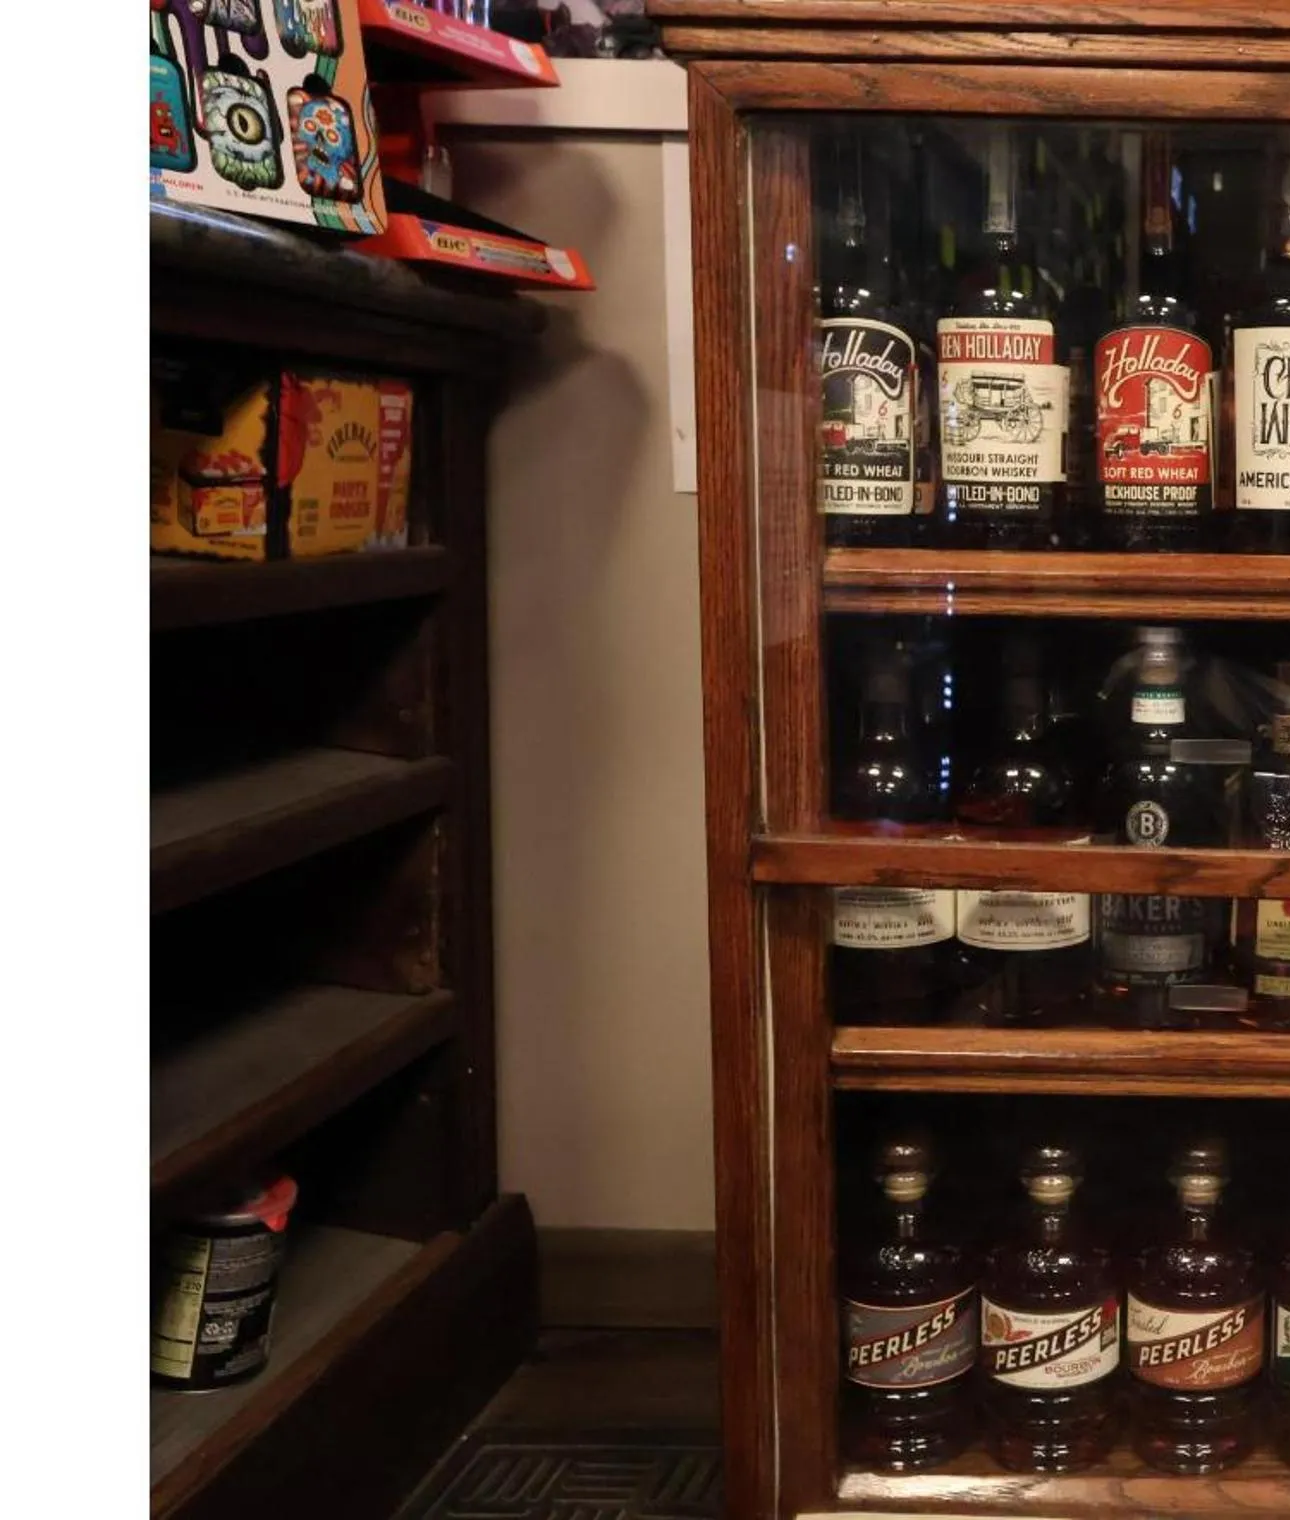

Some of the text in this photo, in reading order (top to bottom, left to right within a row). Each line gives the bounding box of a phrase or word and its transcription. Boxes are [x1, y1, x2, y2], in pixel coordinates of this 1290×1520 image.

[965, 334, 1041, 360] HOLLADAY
[1101, 335, 1200, 393] Holladay
[326, 422, 377, 460] FIREBALL
[834, 464, 859, 476] RED
[863, 464, 903, 477] WHEAT
[987, 453, 1039, 465] STRAIGHT
[991, 466, 1038, 477] WHISKEY
[1104, 467, 1199, 480] SOFT RED WHEAT
[1163, 486, 1198, 501] PROOF
[1140, 813, 1155, 836] B
[850, 1303, 957, 1366] PEERLESS
[996, 1307, 1103, 1371] PEERLESS
[1139, 1308, 1246, 1367] PEERLESS
